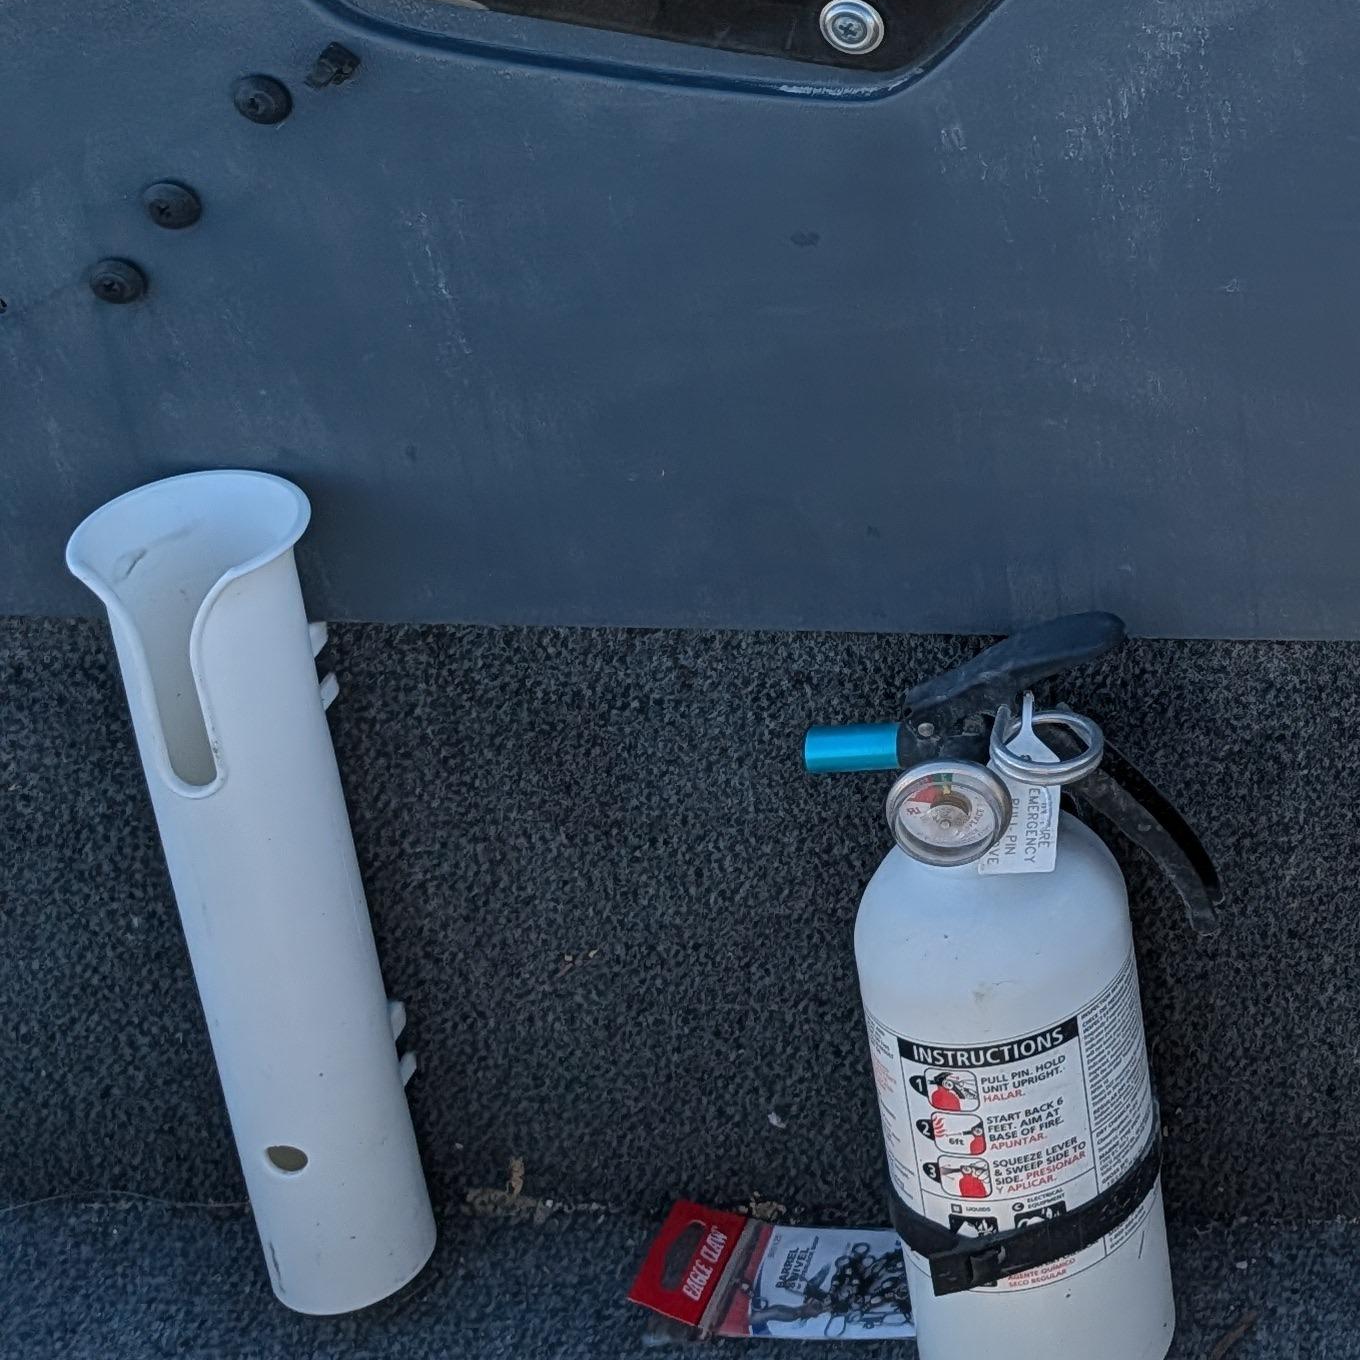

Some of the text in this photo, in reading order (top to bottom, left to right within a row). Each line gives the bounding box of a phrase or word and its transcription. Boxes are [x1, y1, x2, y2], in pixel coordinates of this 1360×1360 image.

[1024, 788, 1040, 864] EMERGENCY
[1005, 836, 1017, 855] PIN
[913, 1028, 1064, 1066] INSTRUCTIONS
[980, 1055, 1066, 1085] PULL PIN. HOLD
[982, 1067, 1063, 1093] UNIT UPRIGHT.
[915, 1080, 923, 1092] 1
[983, 1090, 1026, 1103] HALAR.
[986, 1097, 1064, 1124] START BACK 6
[988, 1108, 1060, 1133] FEET. AIM AT
[922, 1122, 930, 1135] 2
[989, 1118, 1064, 1142] BASE OF FIRE.
[949, 1137, 965, 1146] 6ft
[990, 1134, 1048, 1150] APUNTAR.
[992, 1136, 1078, 1168] SQUEEZE LEVER
[995, 1174, 1023, 1185] SIDE.
[1026, 1151, 1086, 1180] PRESIONAR
[1006, 1161, 1044, 1175] SWEEP
[1046, 1152, 1070, 1167] SIDE
[1073, 1141, 1087, 1154] TO
[928, 1165, 937, 1178] 3
[1007, 1175, 1057, 1193] APLICAR.
[1027, 1188, 1064, 1203] ELECTRICAL
[1027, 1193, 1066, 1209] EQUIPMENT
[682, 1225, 729, 1301] EAGLE CLAW
[775, 1247, 800, 1289] BARREL
[1009, 1269, 1066, 1287] SECO REGULAR
